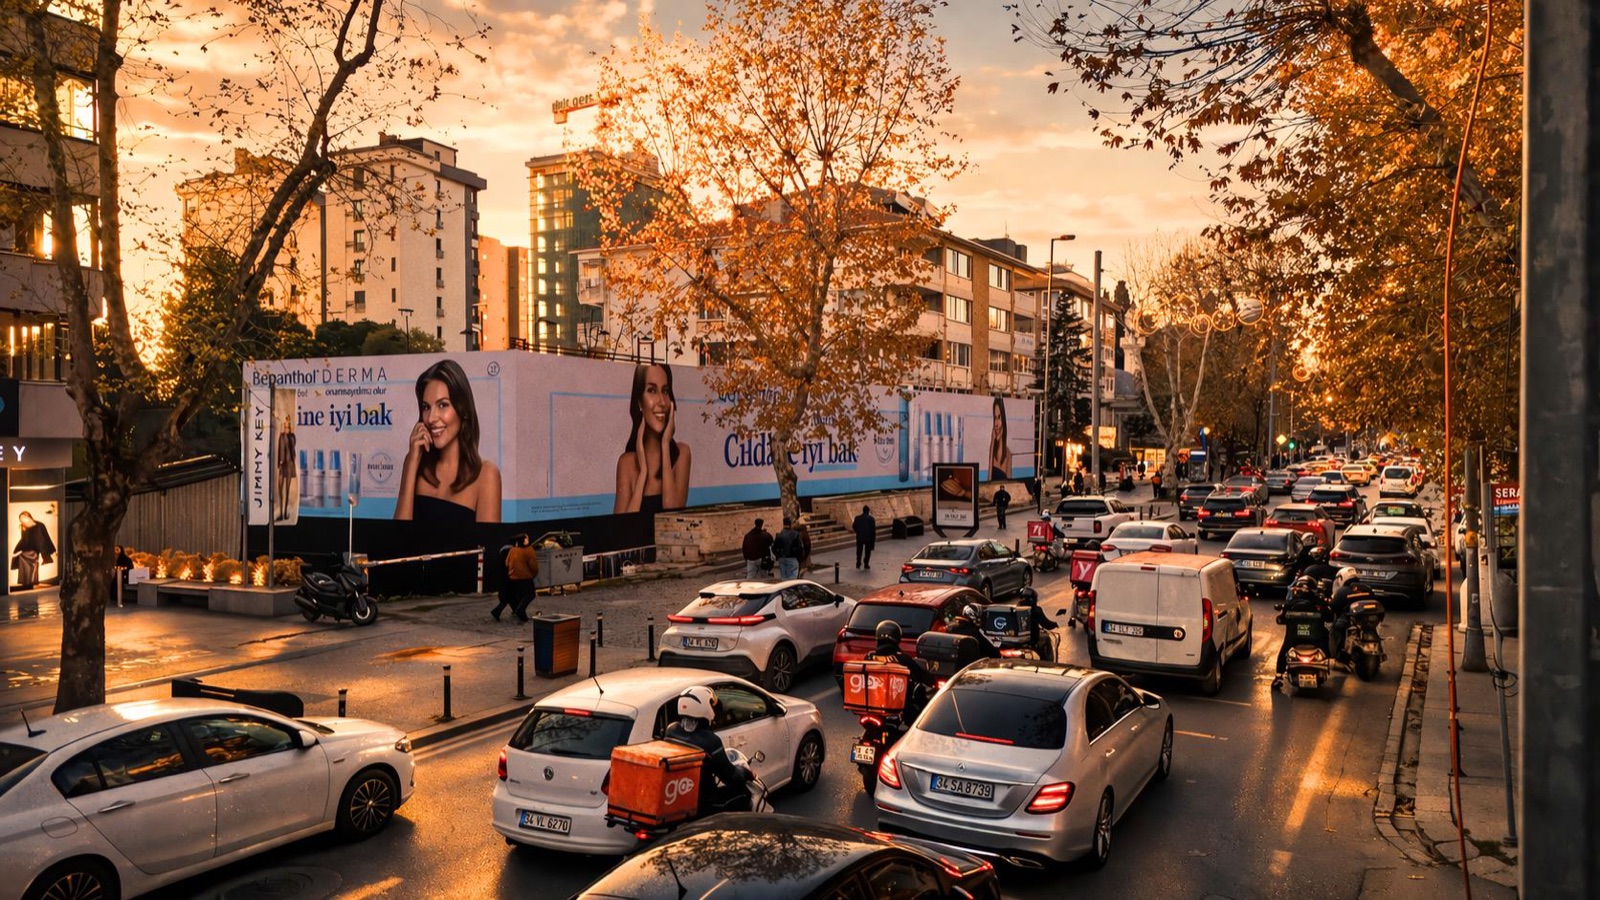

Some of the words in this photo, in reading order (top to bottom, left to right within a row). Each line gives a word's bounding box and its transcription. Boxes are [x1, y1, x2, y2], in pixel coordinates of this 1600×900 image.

[253, 369, 316, 387] Bepanthol
[322, 367, 387, 384] DERMA
[255, 406, 264, 441] KEY
[297, 405, 324, 426] ine
[329, 403, 352, 432] iyi
[356, 402, 393, 426] bak
[724, 432, 798, 468] Cilde
[828, 433, 858, 464] bak
[254, 448, 263, 508] JIMMY
[935, 776, 948, 790] 34
[950, 779, 963, 793] SA
[965, 781, 991, 797] 8739
[525, 812, 534, 825] 34
[547, 817, 568, 832] 6270
